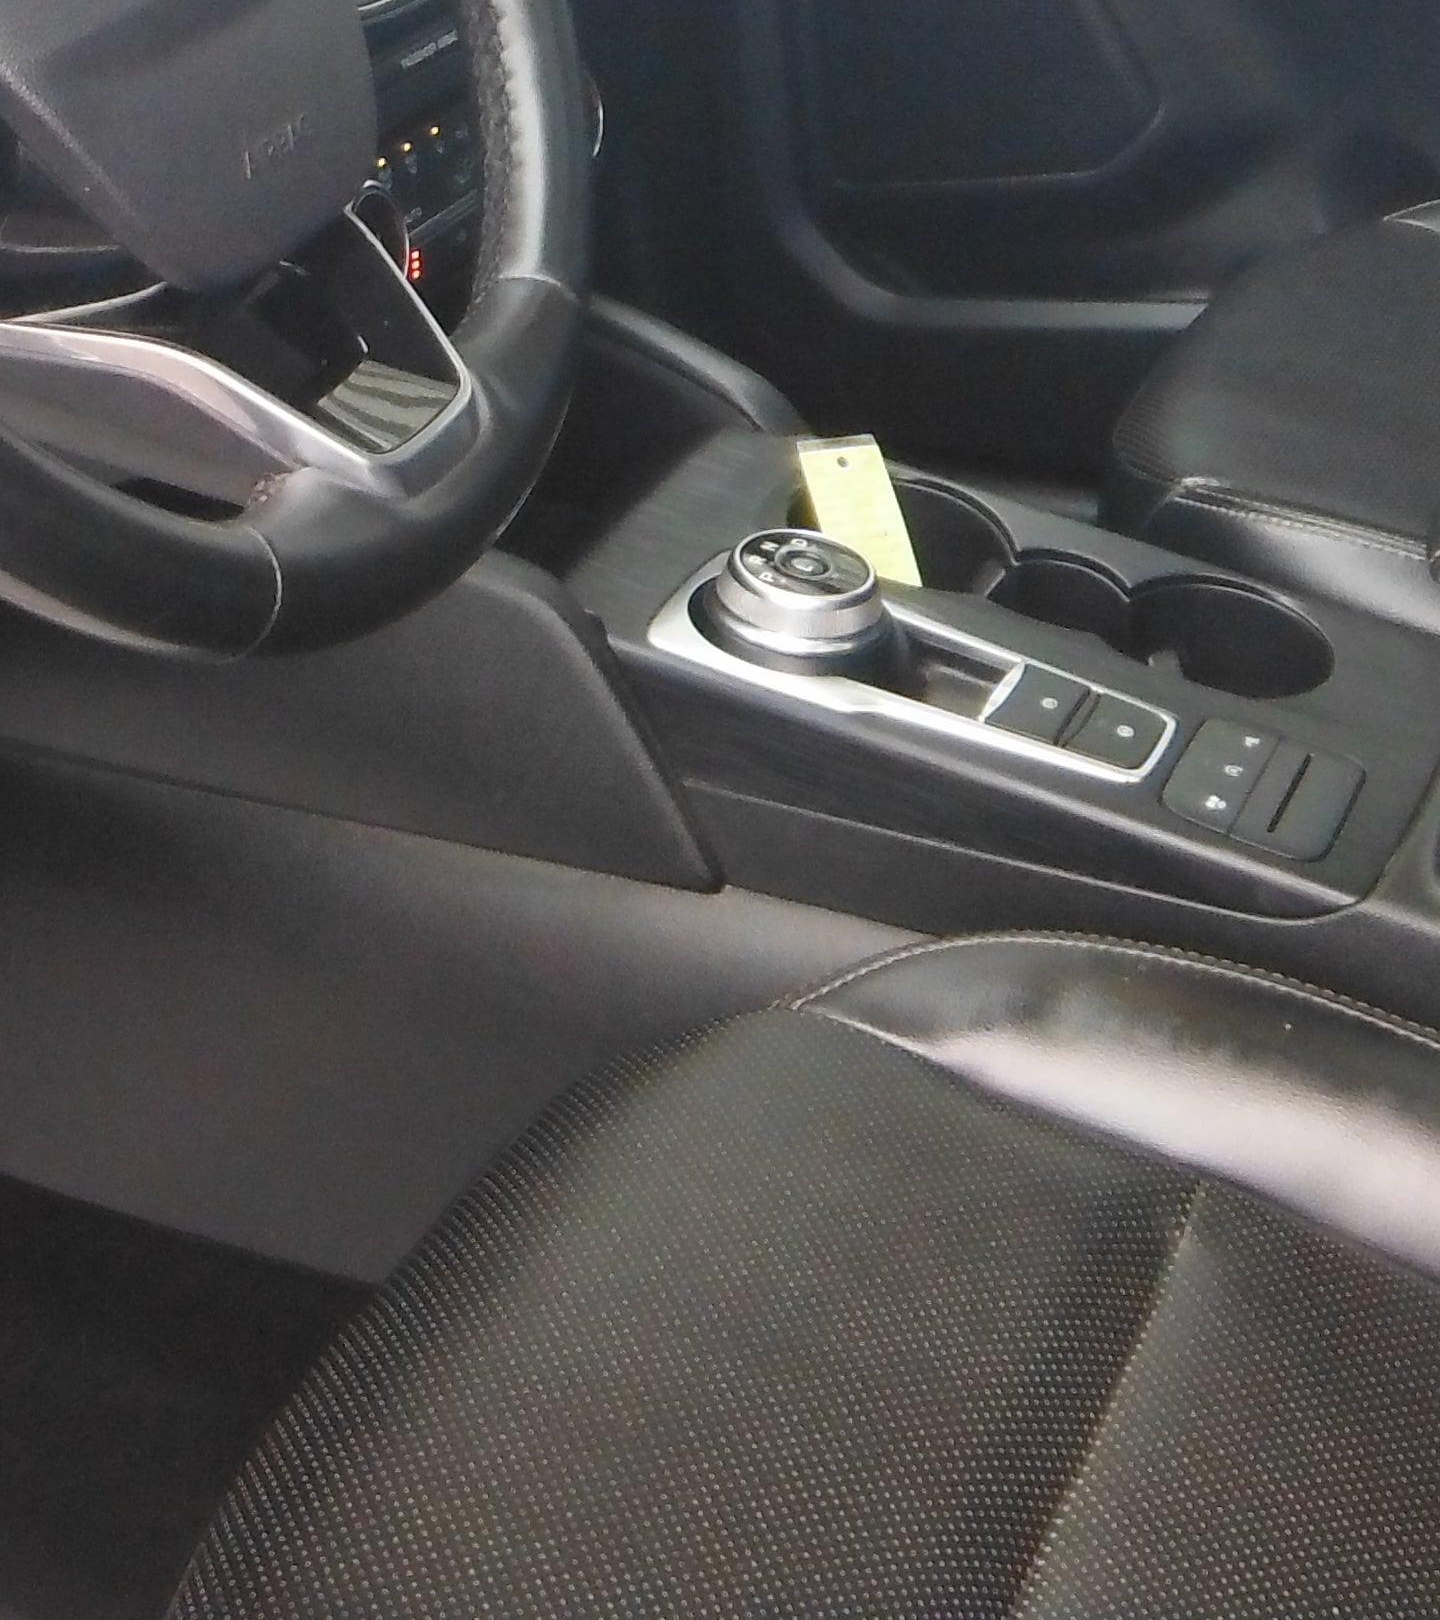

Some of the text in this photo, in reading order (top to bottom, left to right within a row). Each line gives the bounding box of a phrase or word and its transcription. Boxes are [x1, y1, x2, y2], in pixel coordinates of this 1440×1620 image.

[761, 541, 780, 551] N
[749, 556, 767, 565] R
[759, 572, 774, 583] P
